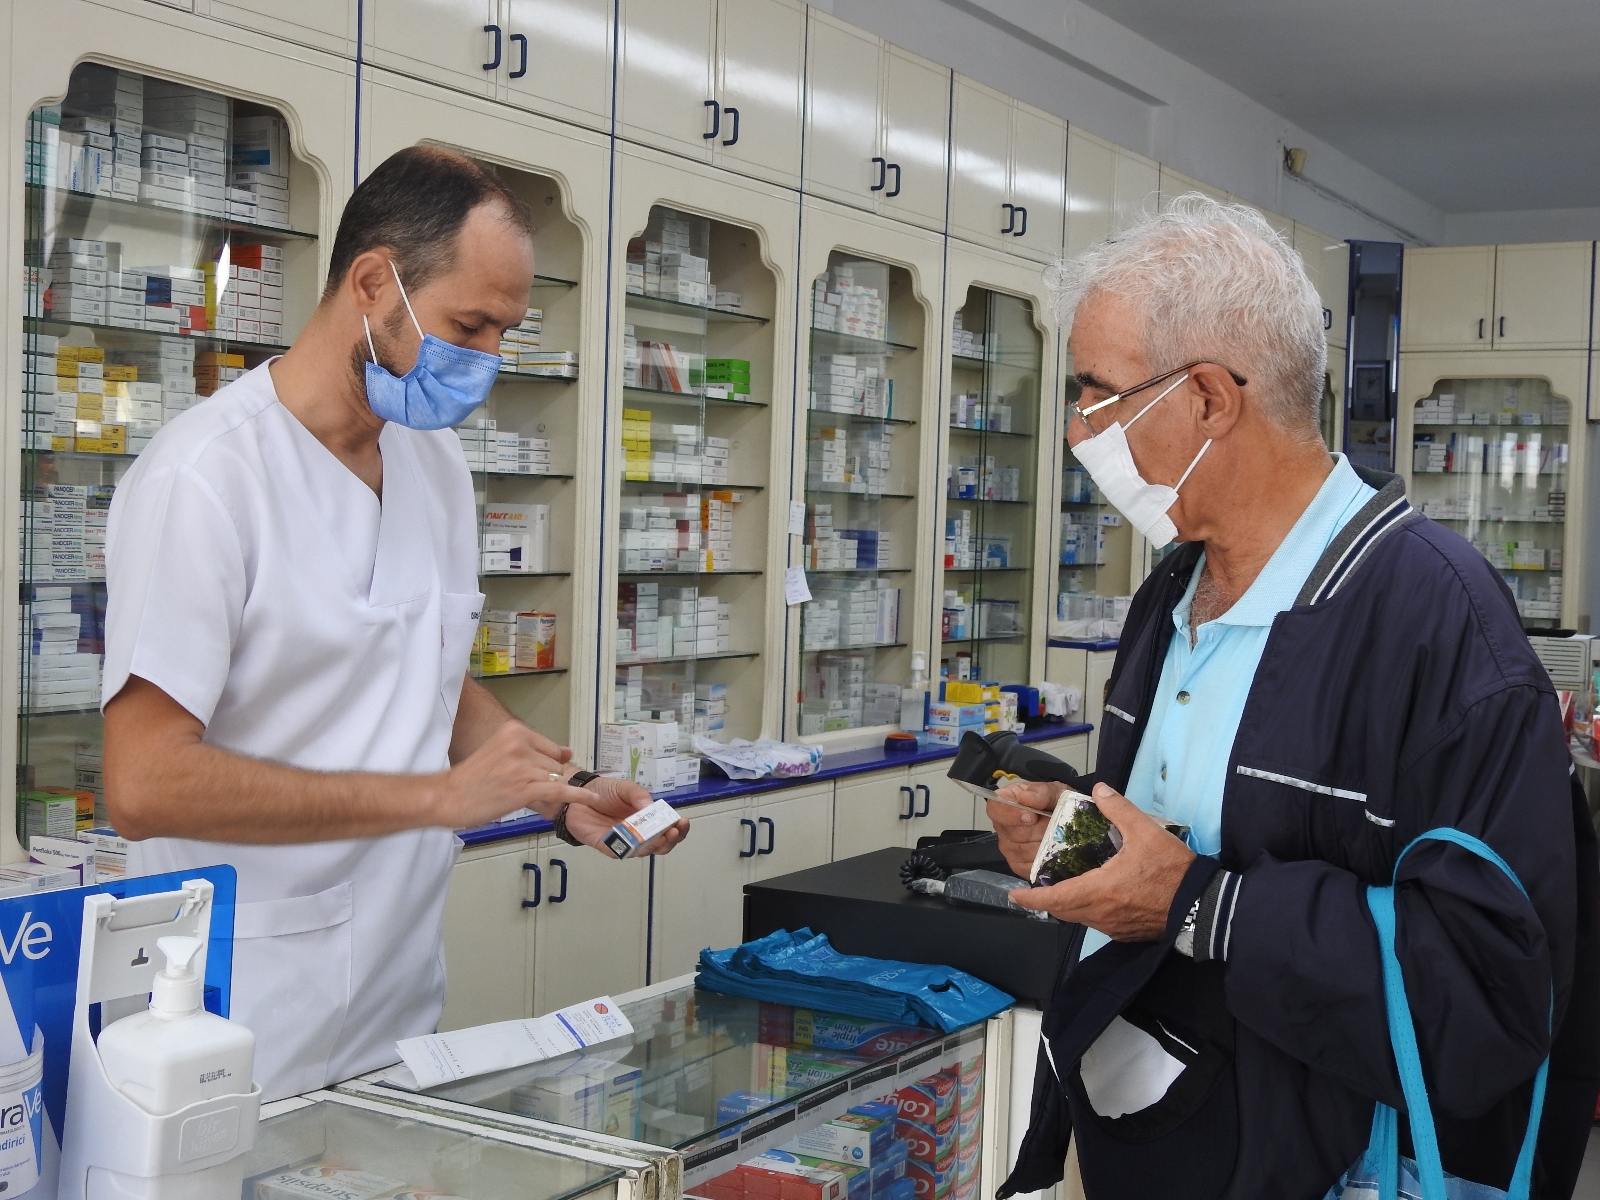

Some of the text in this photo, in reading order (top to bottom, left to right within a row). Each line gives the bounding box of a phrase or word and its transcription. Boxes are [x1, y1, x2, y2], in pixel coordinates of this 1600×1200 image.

[834, 1023, 865, 1035] Action
[831, 1032, 857, 1044] Triple
[276, 1174, 360, 1200] Strepsils
